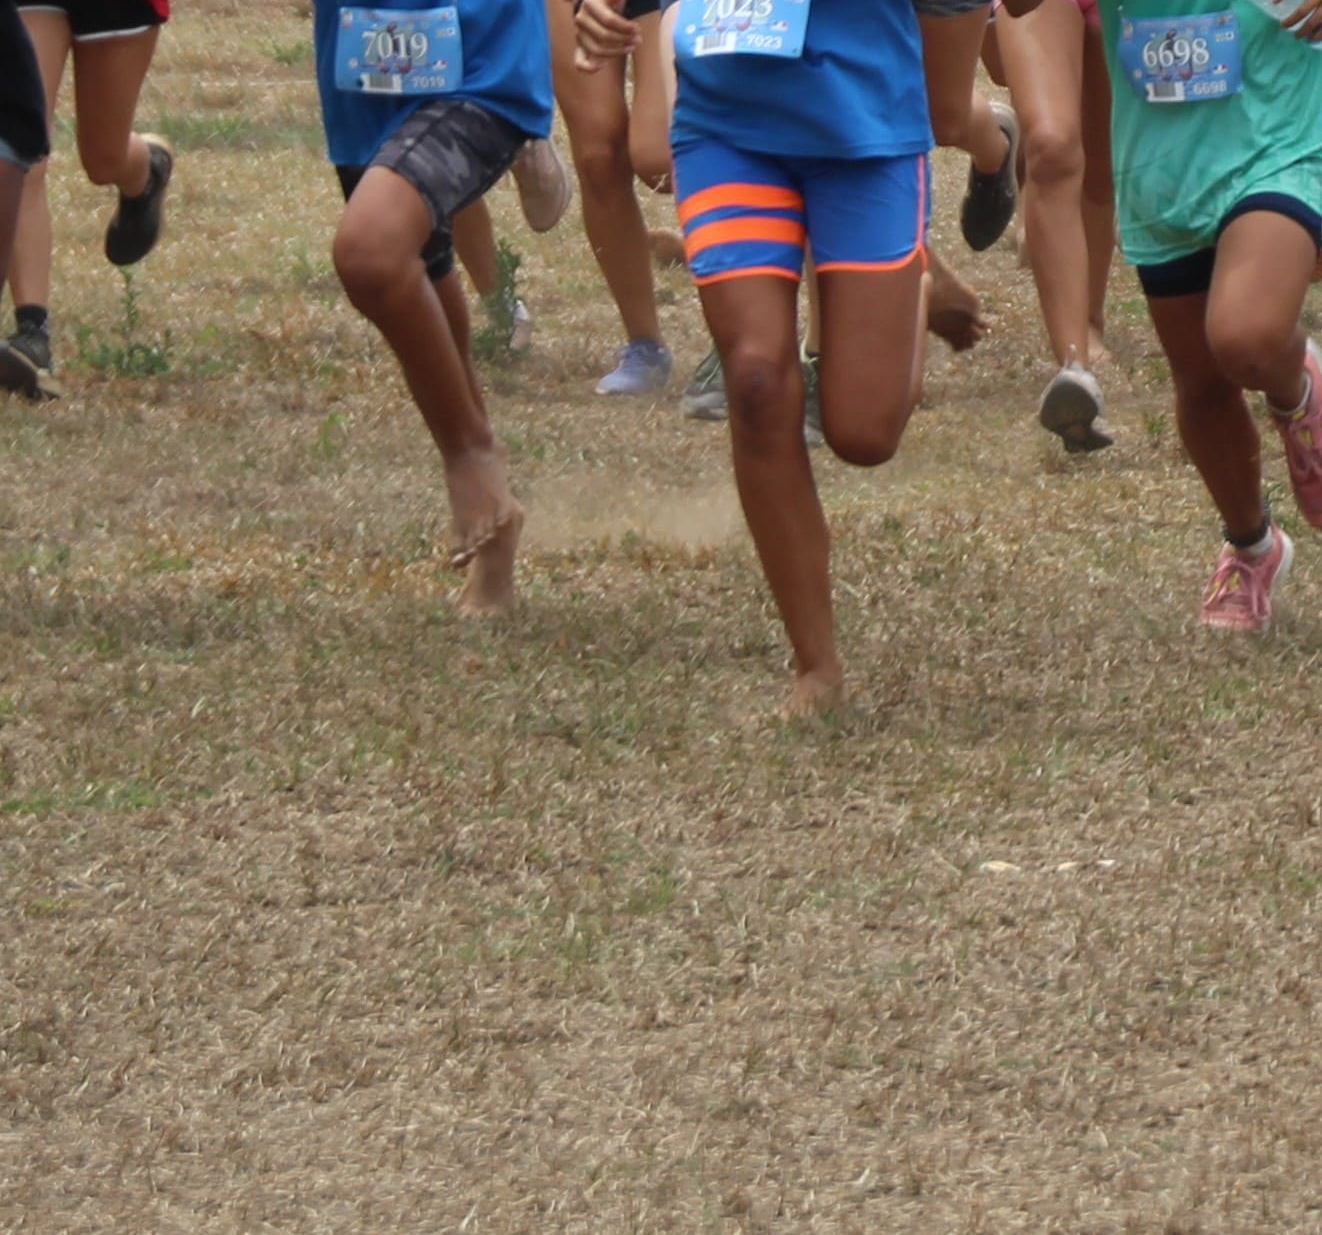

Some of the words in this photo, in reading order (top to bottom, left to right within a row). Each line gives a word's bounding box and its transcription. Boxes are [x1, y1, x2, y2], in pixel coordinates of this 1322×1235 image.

[361, 30, 430, 63] 7019
[746, 34, 783, 50] 7023
[1142, 37, 1211, 68] 6698
[411, 76, 446, 90] 7019
[1193, 80, 1228, 96] 6698
